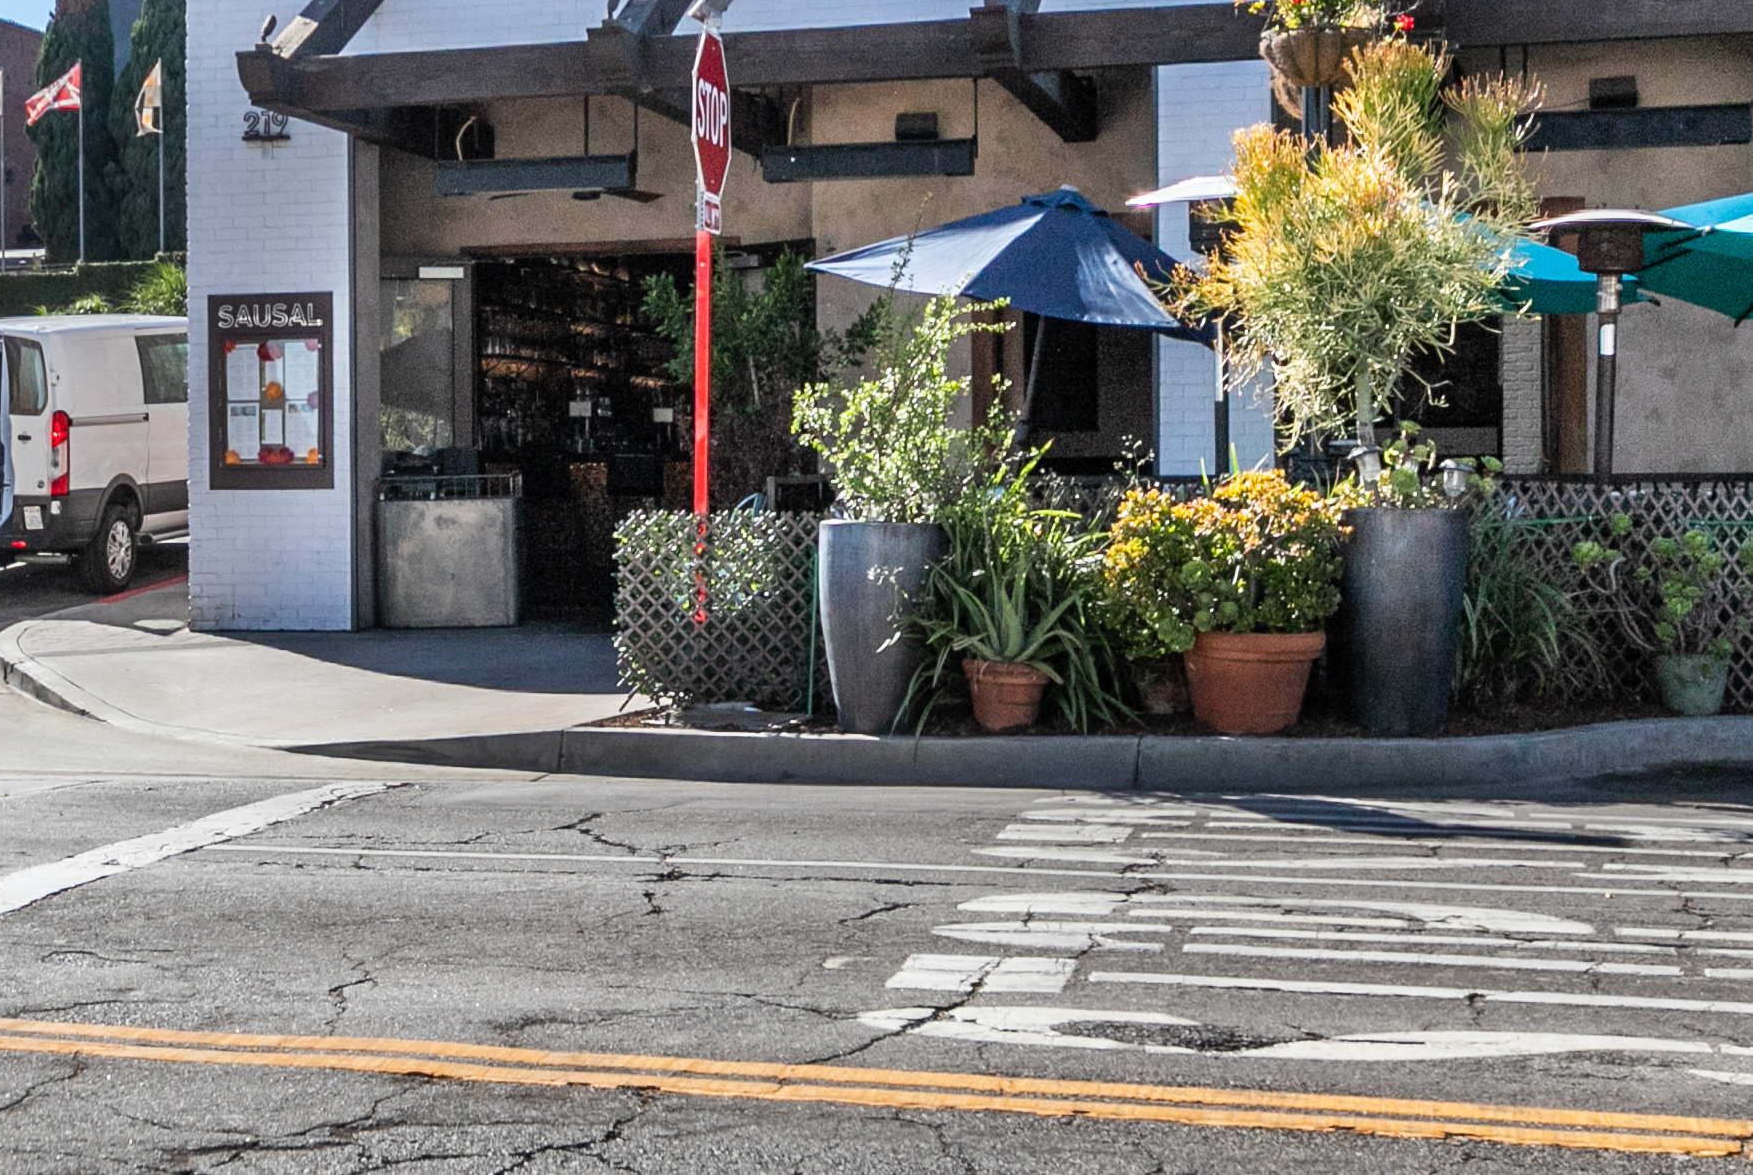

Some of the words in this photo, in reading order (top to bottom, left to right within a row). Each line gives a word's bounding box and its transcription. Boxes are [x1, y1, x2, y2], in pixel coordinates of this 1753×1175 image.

[243, 110, 288, 136] 219
[697, 78, 728, 148] STOP
[218, 303, 323, 328] SAUSAL
